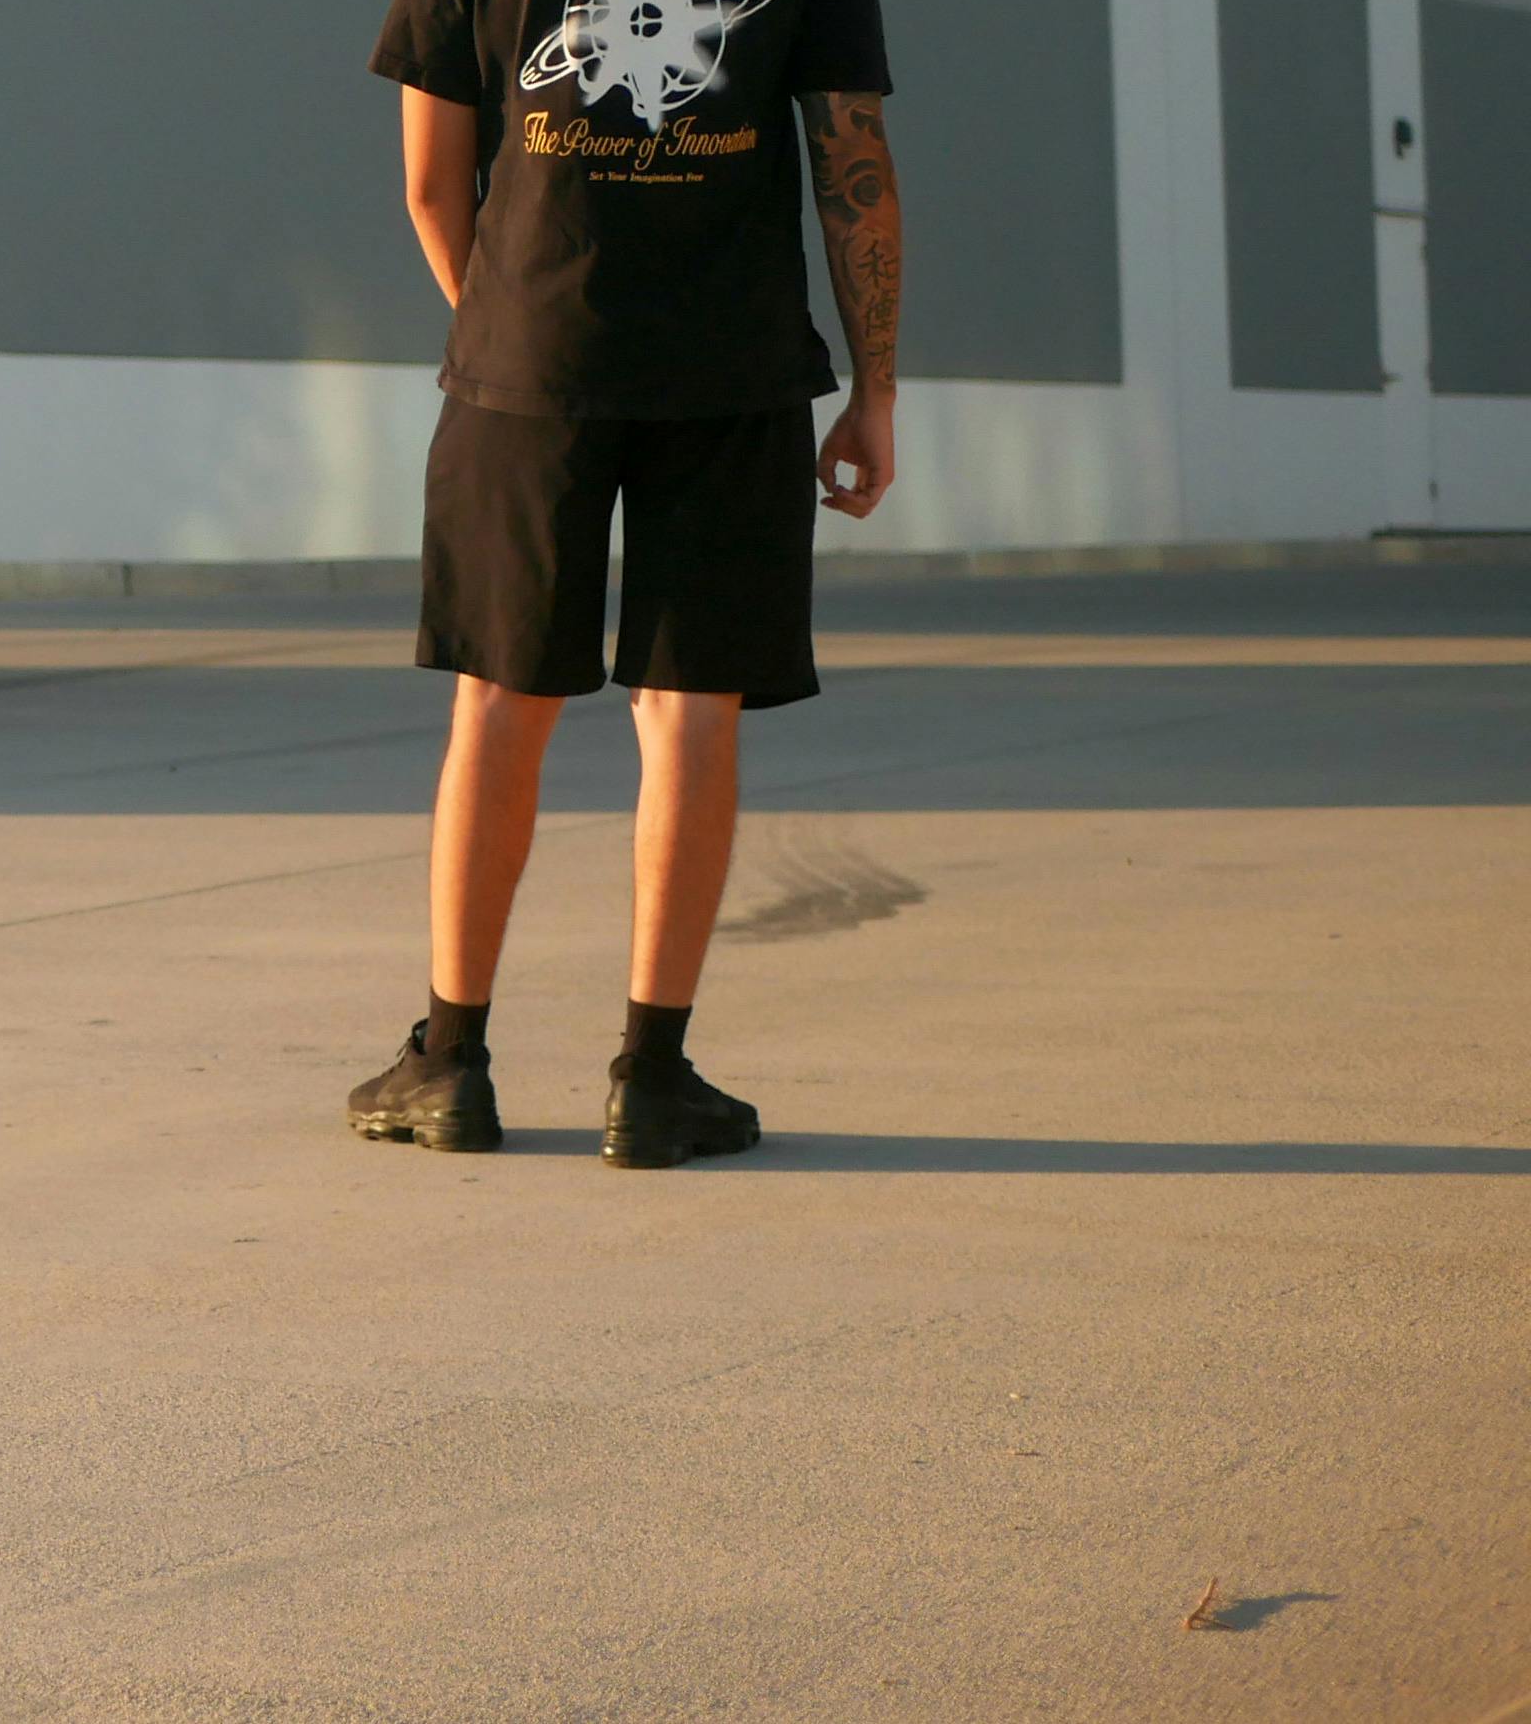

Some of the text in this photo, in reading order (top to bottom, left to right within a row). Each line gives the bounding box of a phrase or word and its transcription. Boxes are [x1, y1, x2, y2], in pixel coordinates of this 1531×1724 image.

[524, 111, 757, 171] The Power of Innovation
[630, 172, 683, 184] Imagination
